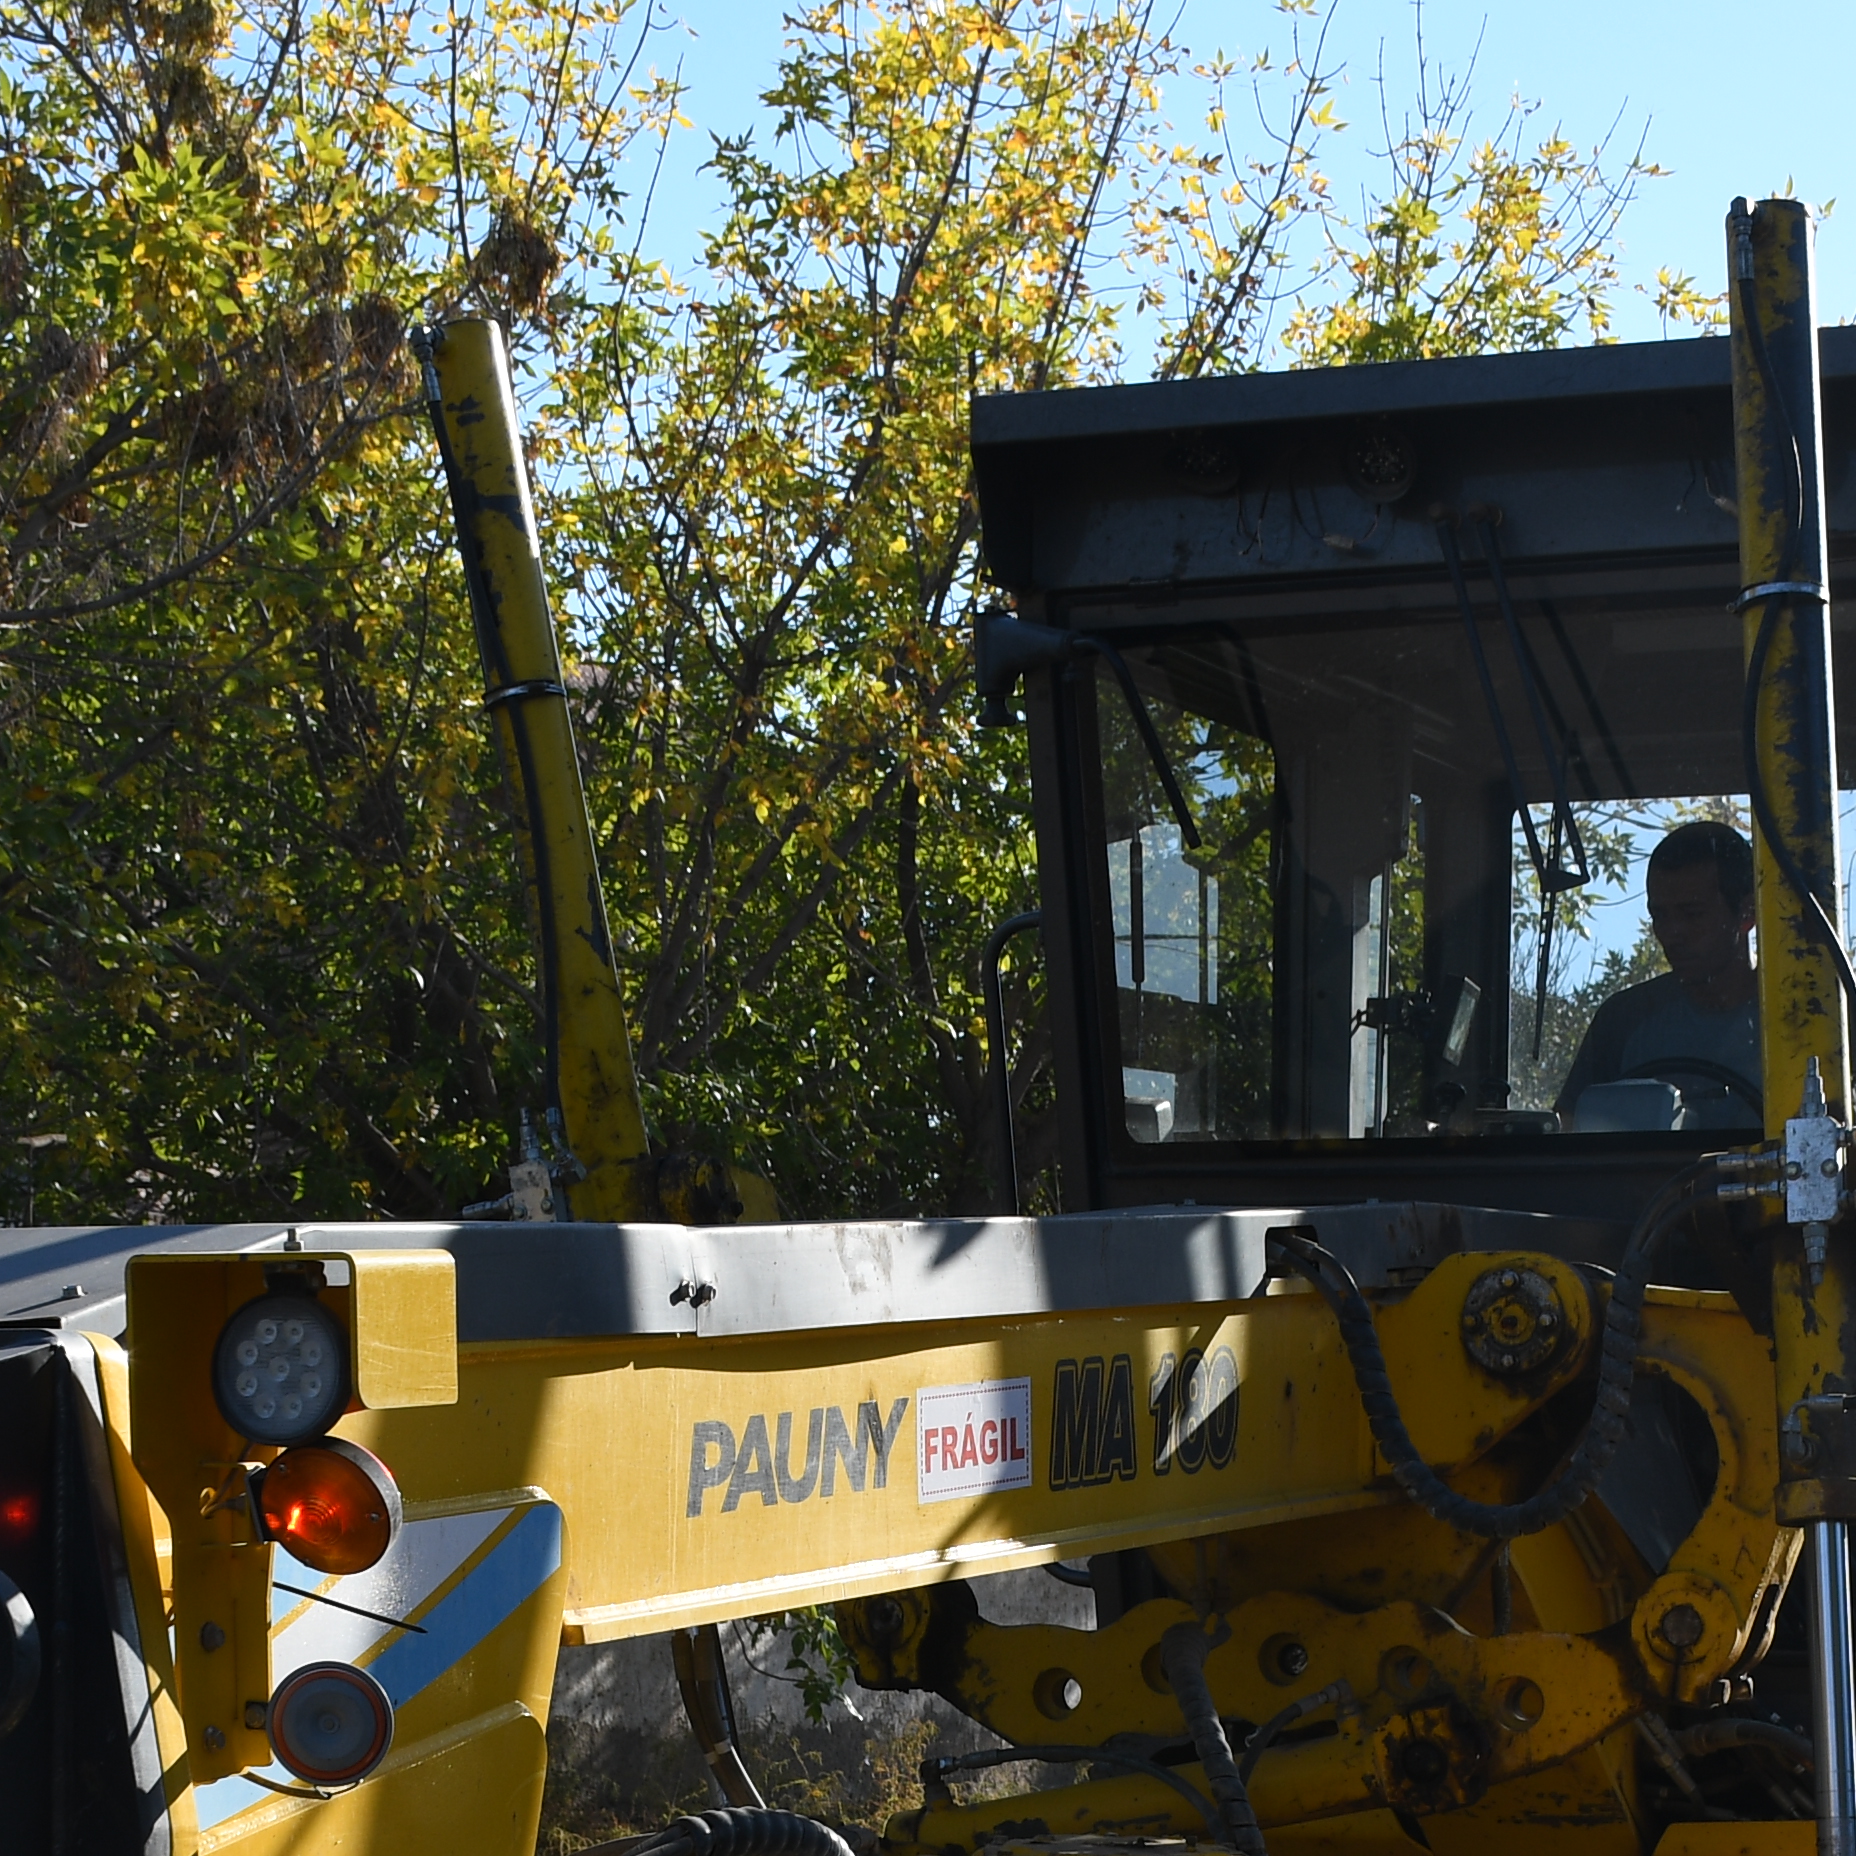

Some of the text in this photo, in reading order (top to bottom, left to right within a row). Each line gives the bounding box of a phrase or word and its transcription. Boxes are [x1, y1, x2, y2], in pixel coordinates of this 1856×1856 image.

[685, 1395, 910, 1520] PAUNY
[923, 1412, 1026, 1474] FRÁGIL
[1048, 1344, 1240, 1492] MA 180
